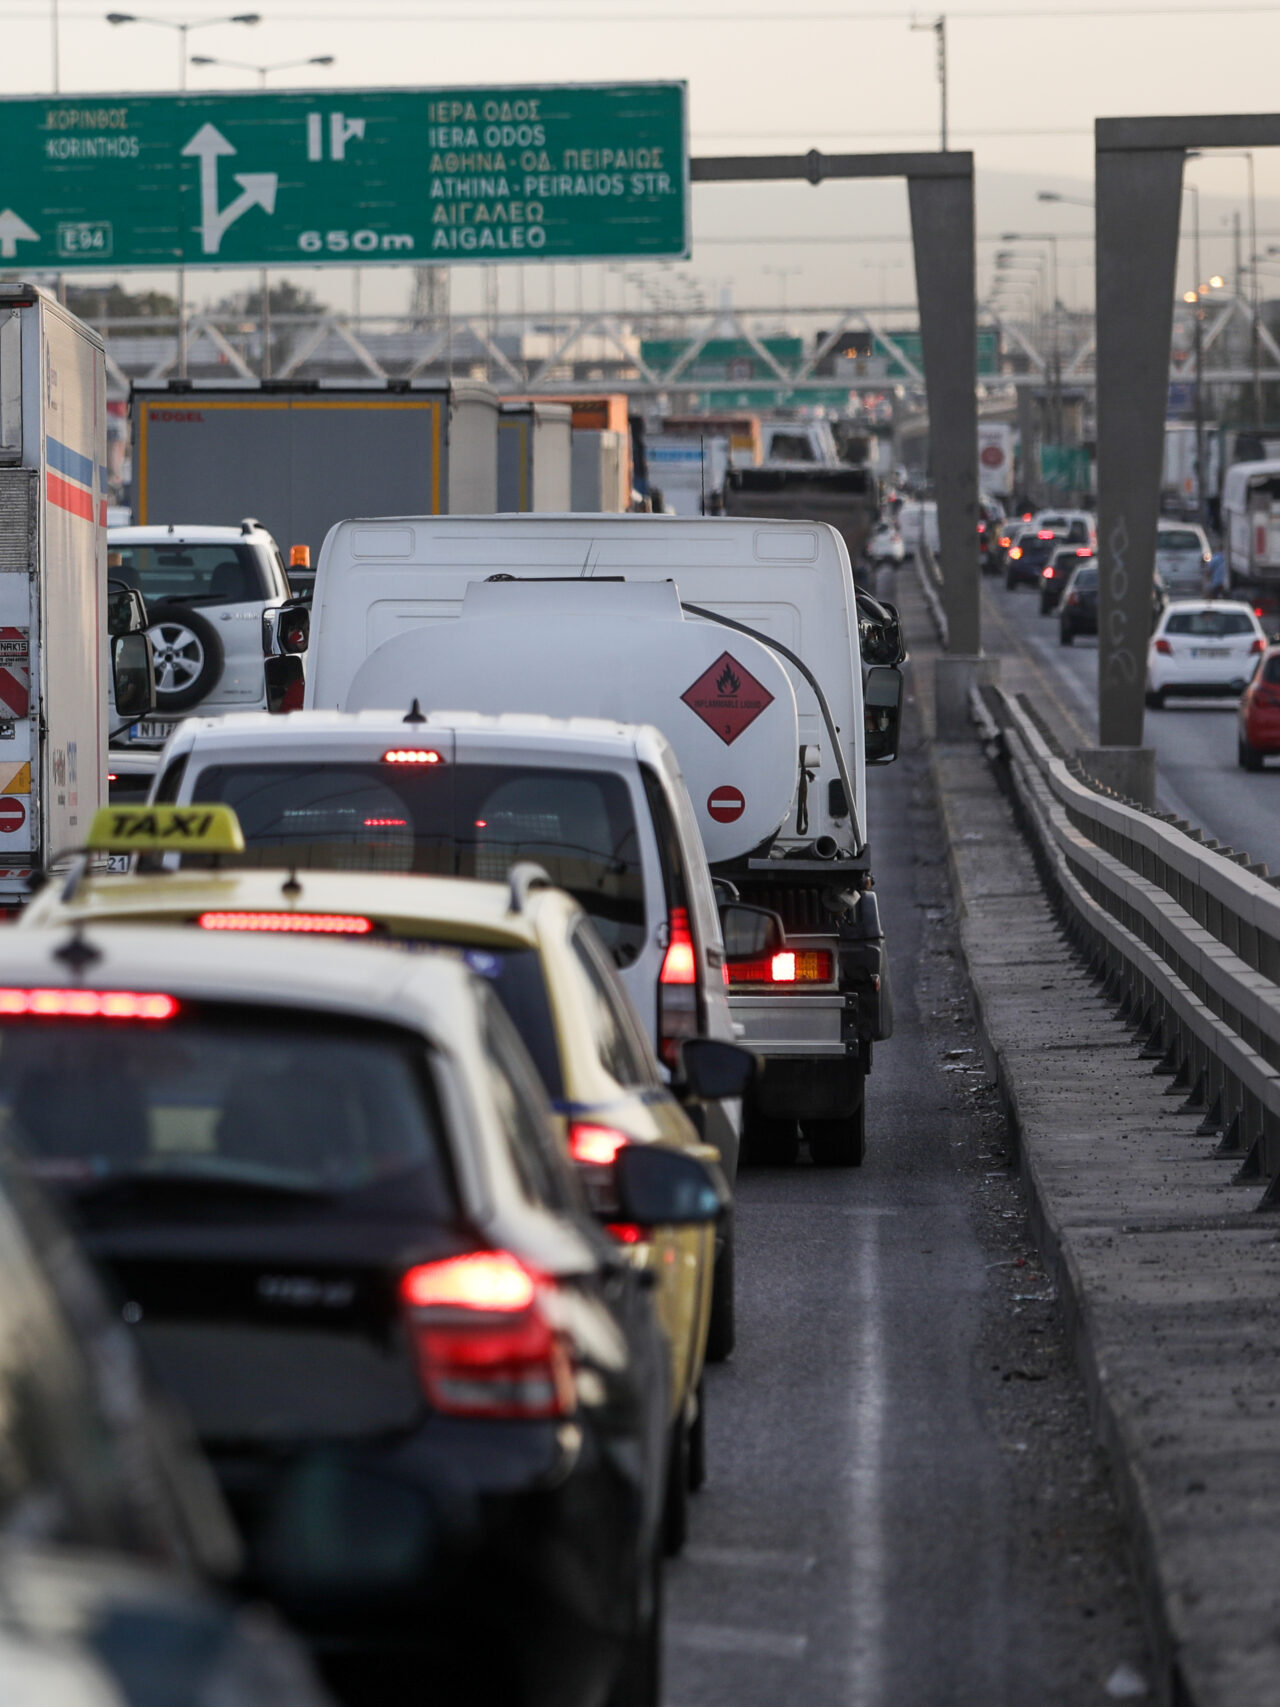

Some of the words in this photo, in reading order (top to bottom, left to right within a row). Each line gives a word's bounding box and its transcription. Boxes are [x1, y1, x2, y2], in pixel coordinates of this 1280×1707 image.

[45, 108, 129, 130] ΚΟΡΙΝΘΟΣ
[428, 102, 477, 122] ΙΕΡΑ
[483, 100, 541, 121] ΟΔΟΣ
[429, 126, 479, 147] IERA
[483, 125, 546, 147] ODOS
[45, 137, 139, 158] KORINTHOS
[563, 148, 664, 169] ΠΕΙΡΑΙΩΣ
[429, 177, 510, 198] ATHINA
[524, 175, 624, 197] PEIRAIOS
[630, 174, 676, 195] STR.
[431, 202, 545, 224] ΑΙΓΑΛΕΩ
[62, 228, 104, 249] E94
[298, 231, 415, 252] 650m
[431, 226, 546, 249] AIGALEO
[724, 725, 732, 734] 3
[111, 813, 215, 838] TAXI
